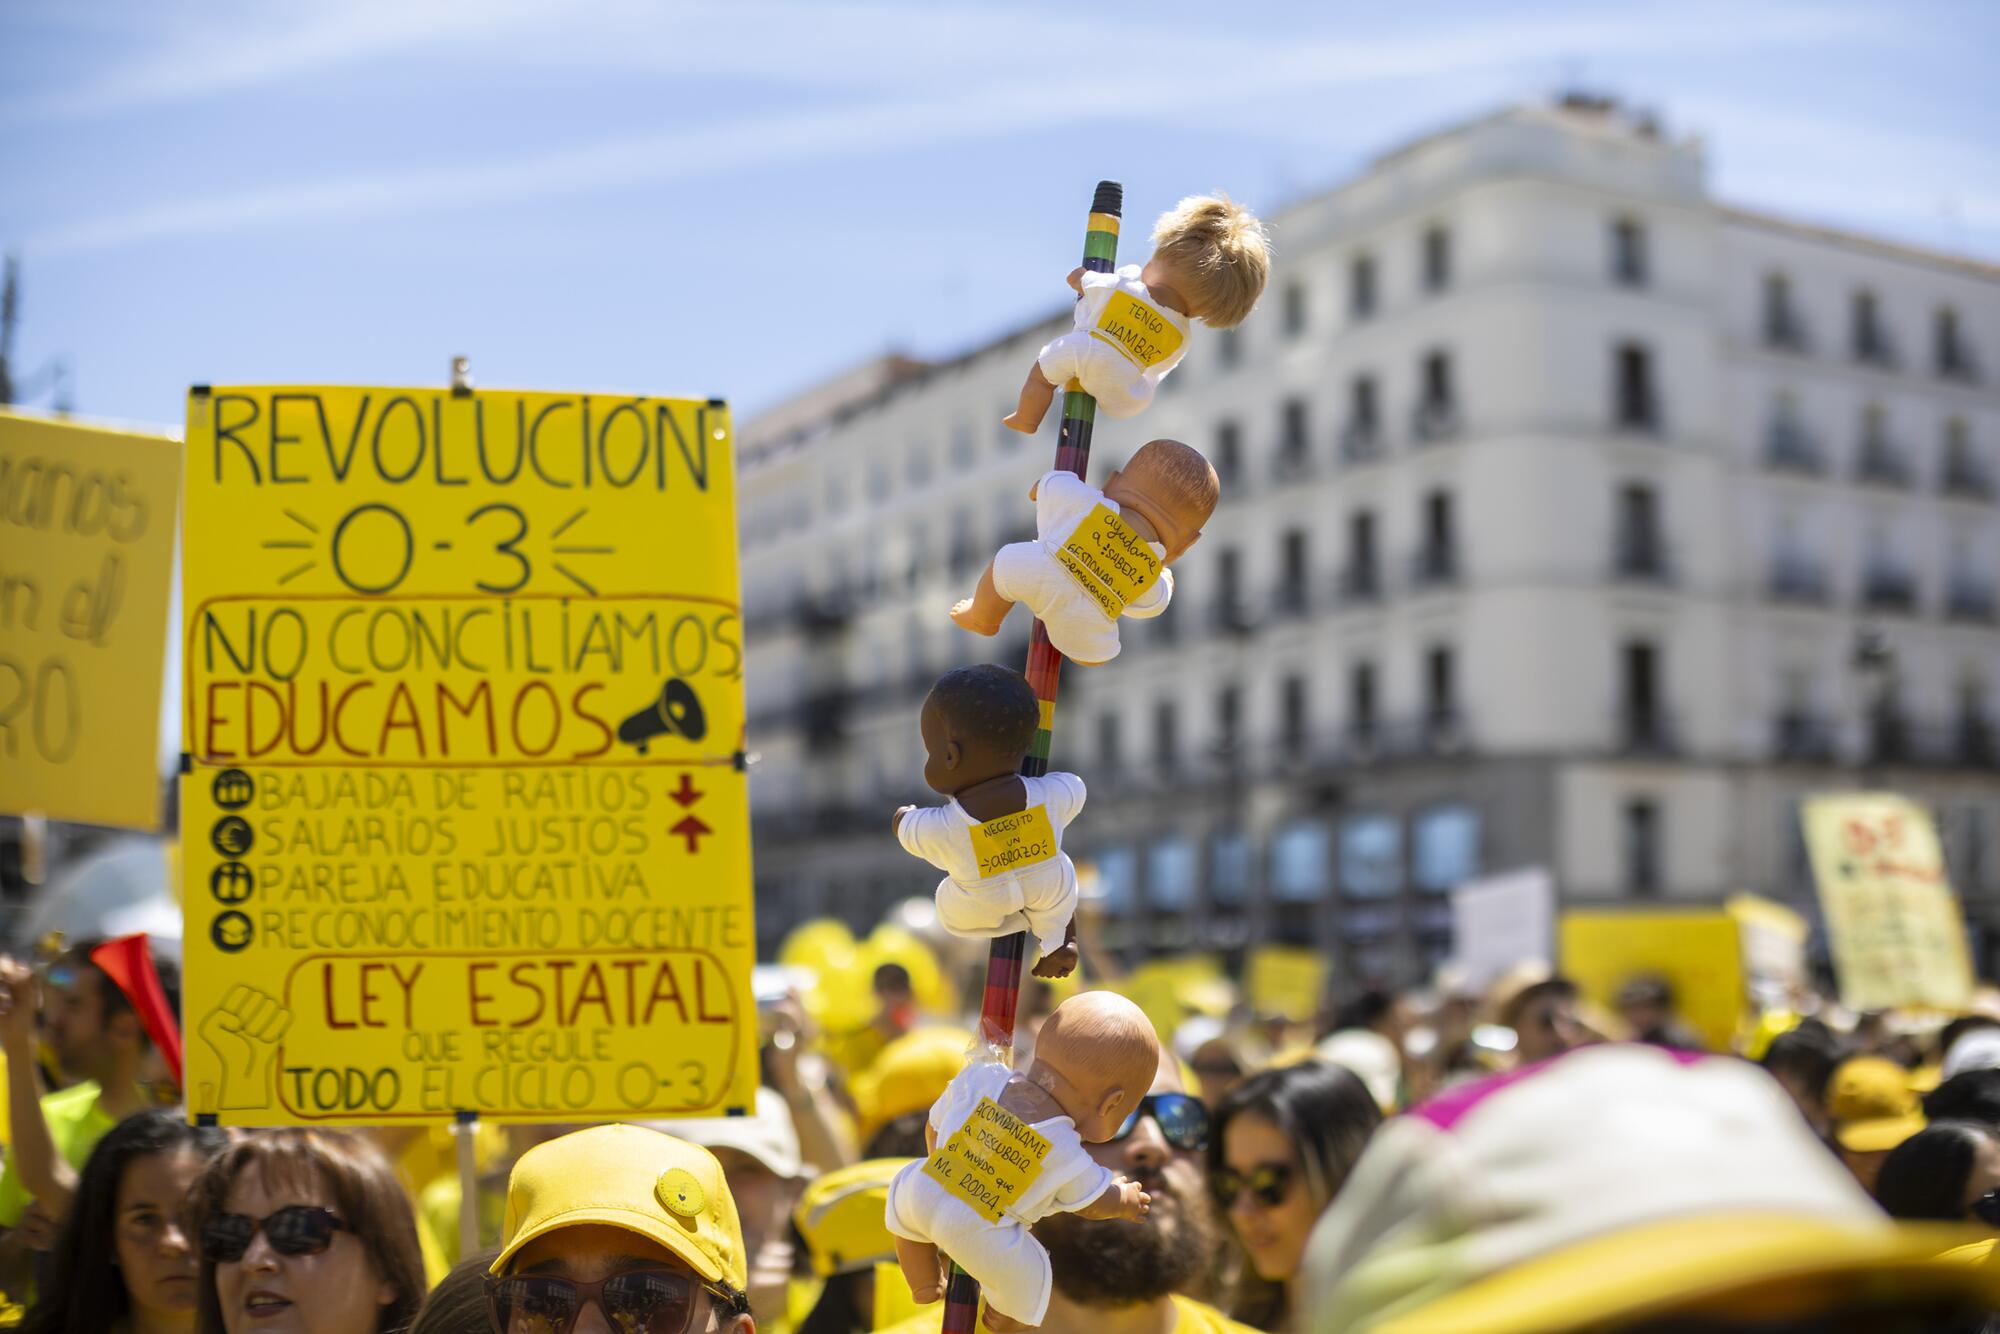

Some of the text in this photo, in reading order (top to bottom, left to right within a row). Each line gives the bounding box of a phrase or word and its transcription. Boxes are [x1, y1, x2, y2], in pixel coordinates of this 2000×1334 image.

[1128, 302, 1163, 334] TENGO
[213, 393, 709, 493] REVOLUCIÓN
[0, 452, 150, 545] anos
[331, 502, 533, 596] 0-3
[1106, 548, 1138, 582] SABER
[204, 607, 308, 682] NO
[206, 679, 616, 760] EDUCAMOS
[258, 767, 651, 812] BAJADA DE RATIOS
[260, 808, 651, 857] SALARIOS JUSTOS
[983, 813, 1033, 838] NECESITO
[1006, 837, 1021, 847] UN
[258, 855, 652, 904] PAREJA EDUCATIVA
[260, 902, 748, 950] RECONOCIMIENTO DOCENTE
[322, 958, 734, 1030] LEY ESTATAL
[400, 1026, 614, 1064] QUE REGULE
[283, 1060, 710, 1112] TODO EL CICLO 0-3
[948, 1142, 1015, 1194] el MUNDO que
[976, 1128, 1031, 1174] DESCUBRIR
